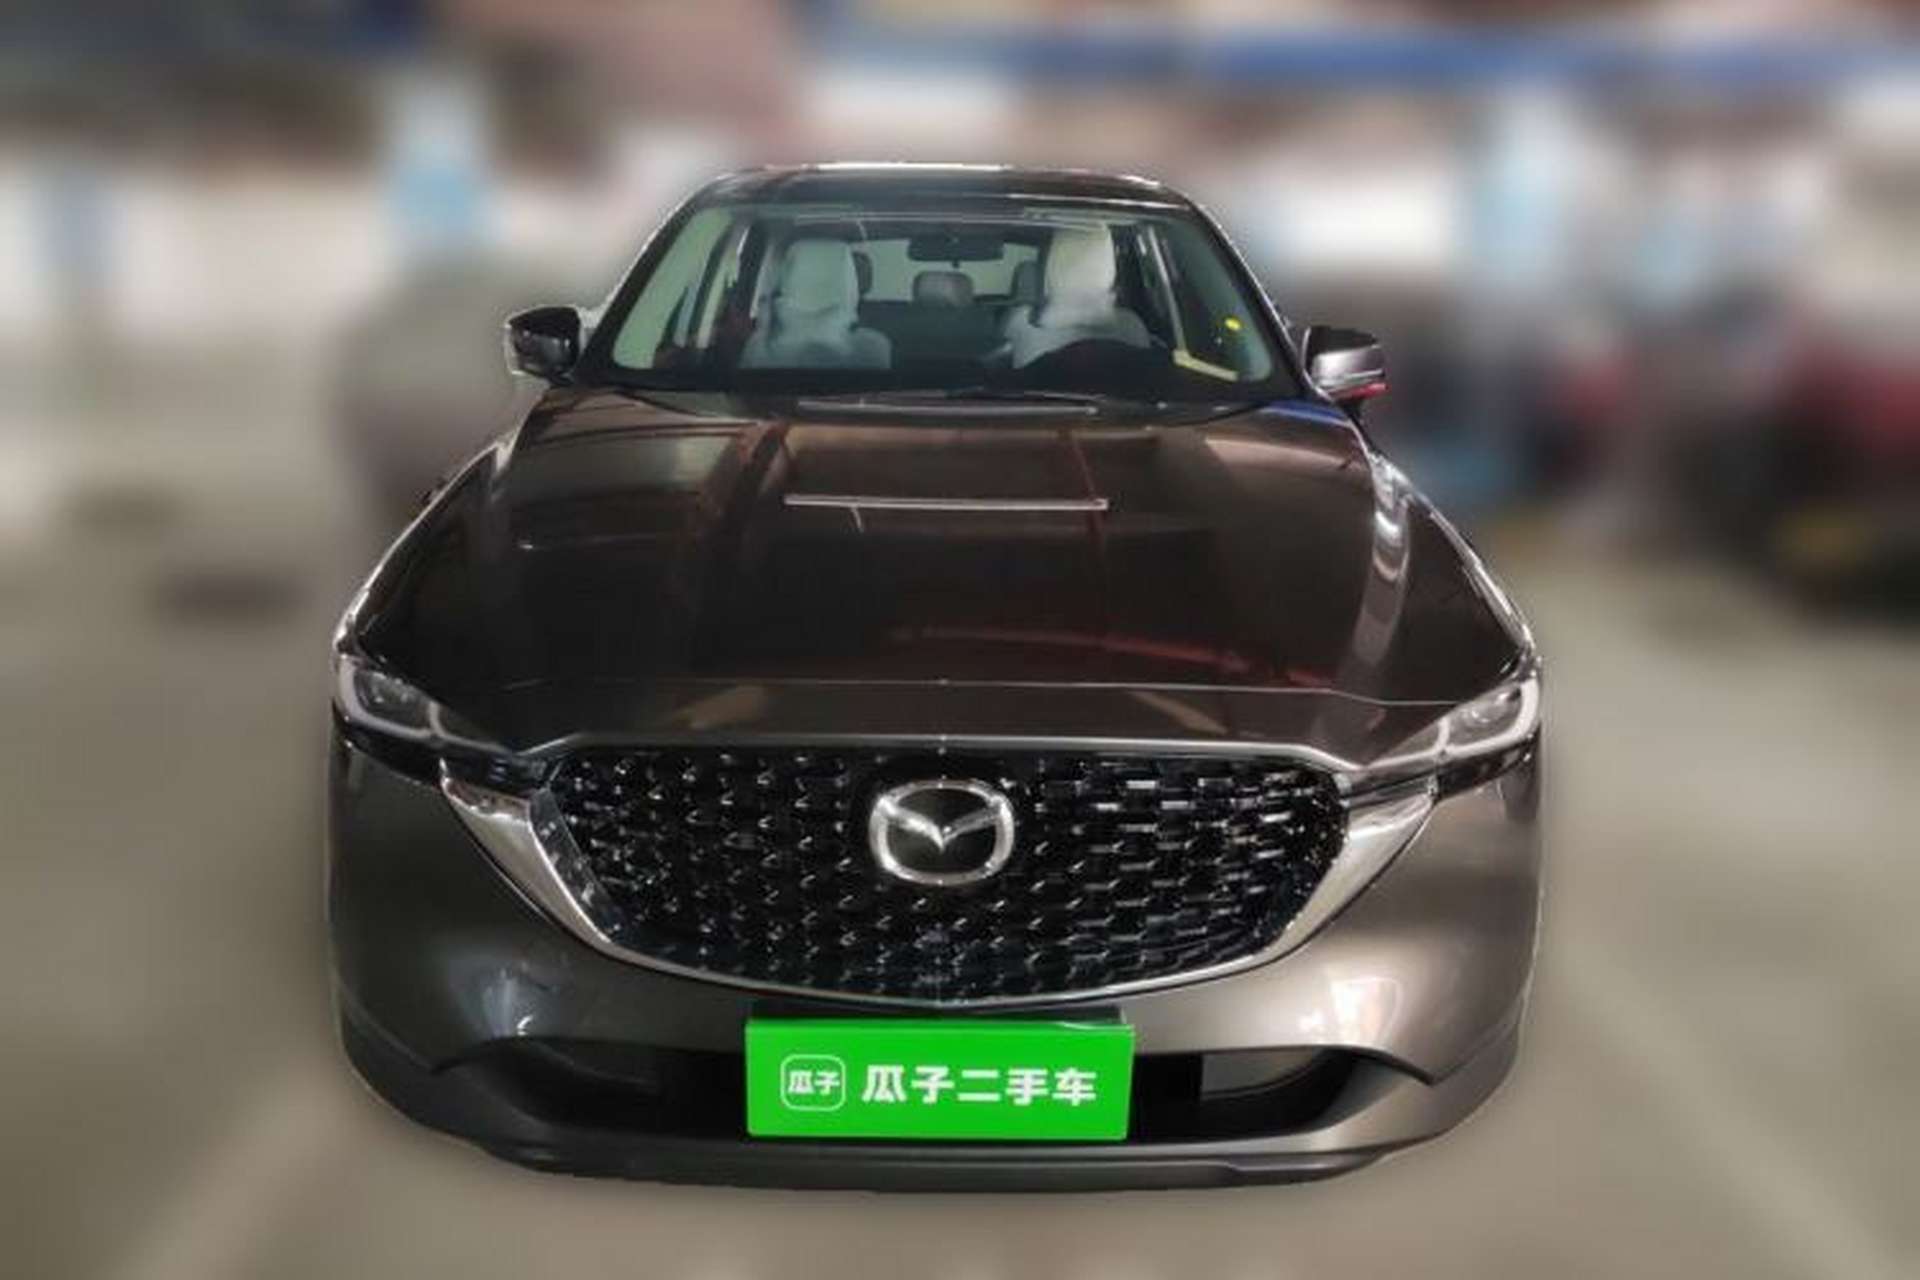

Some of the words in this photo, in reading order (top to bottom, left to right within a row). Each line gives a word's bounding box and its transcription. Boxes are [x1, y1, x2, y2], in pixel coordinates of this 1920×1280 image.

[787, 1070, 841, 1095] 瓜子
[861, 1064, 1097, 1106] 瓜子二手车
